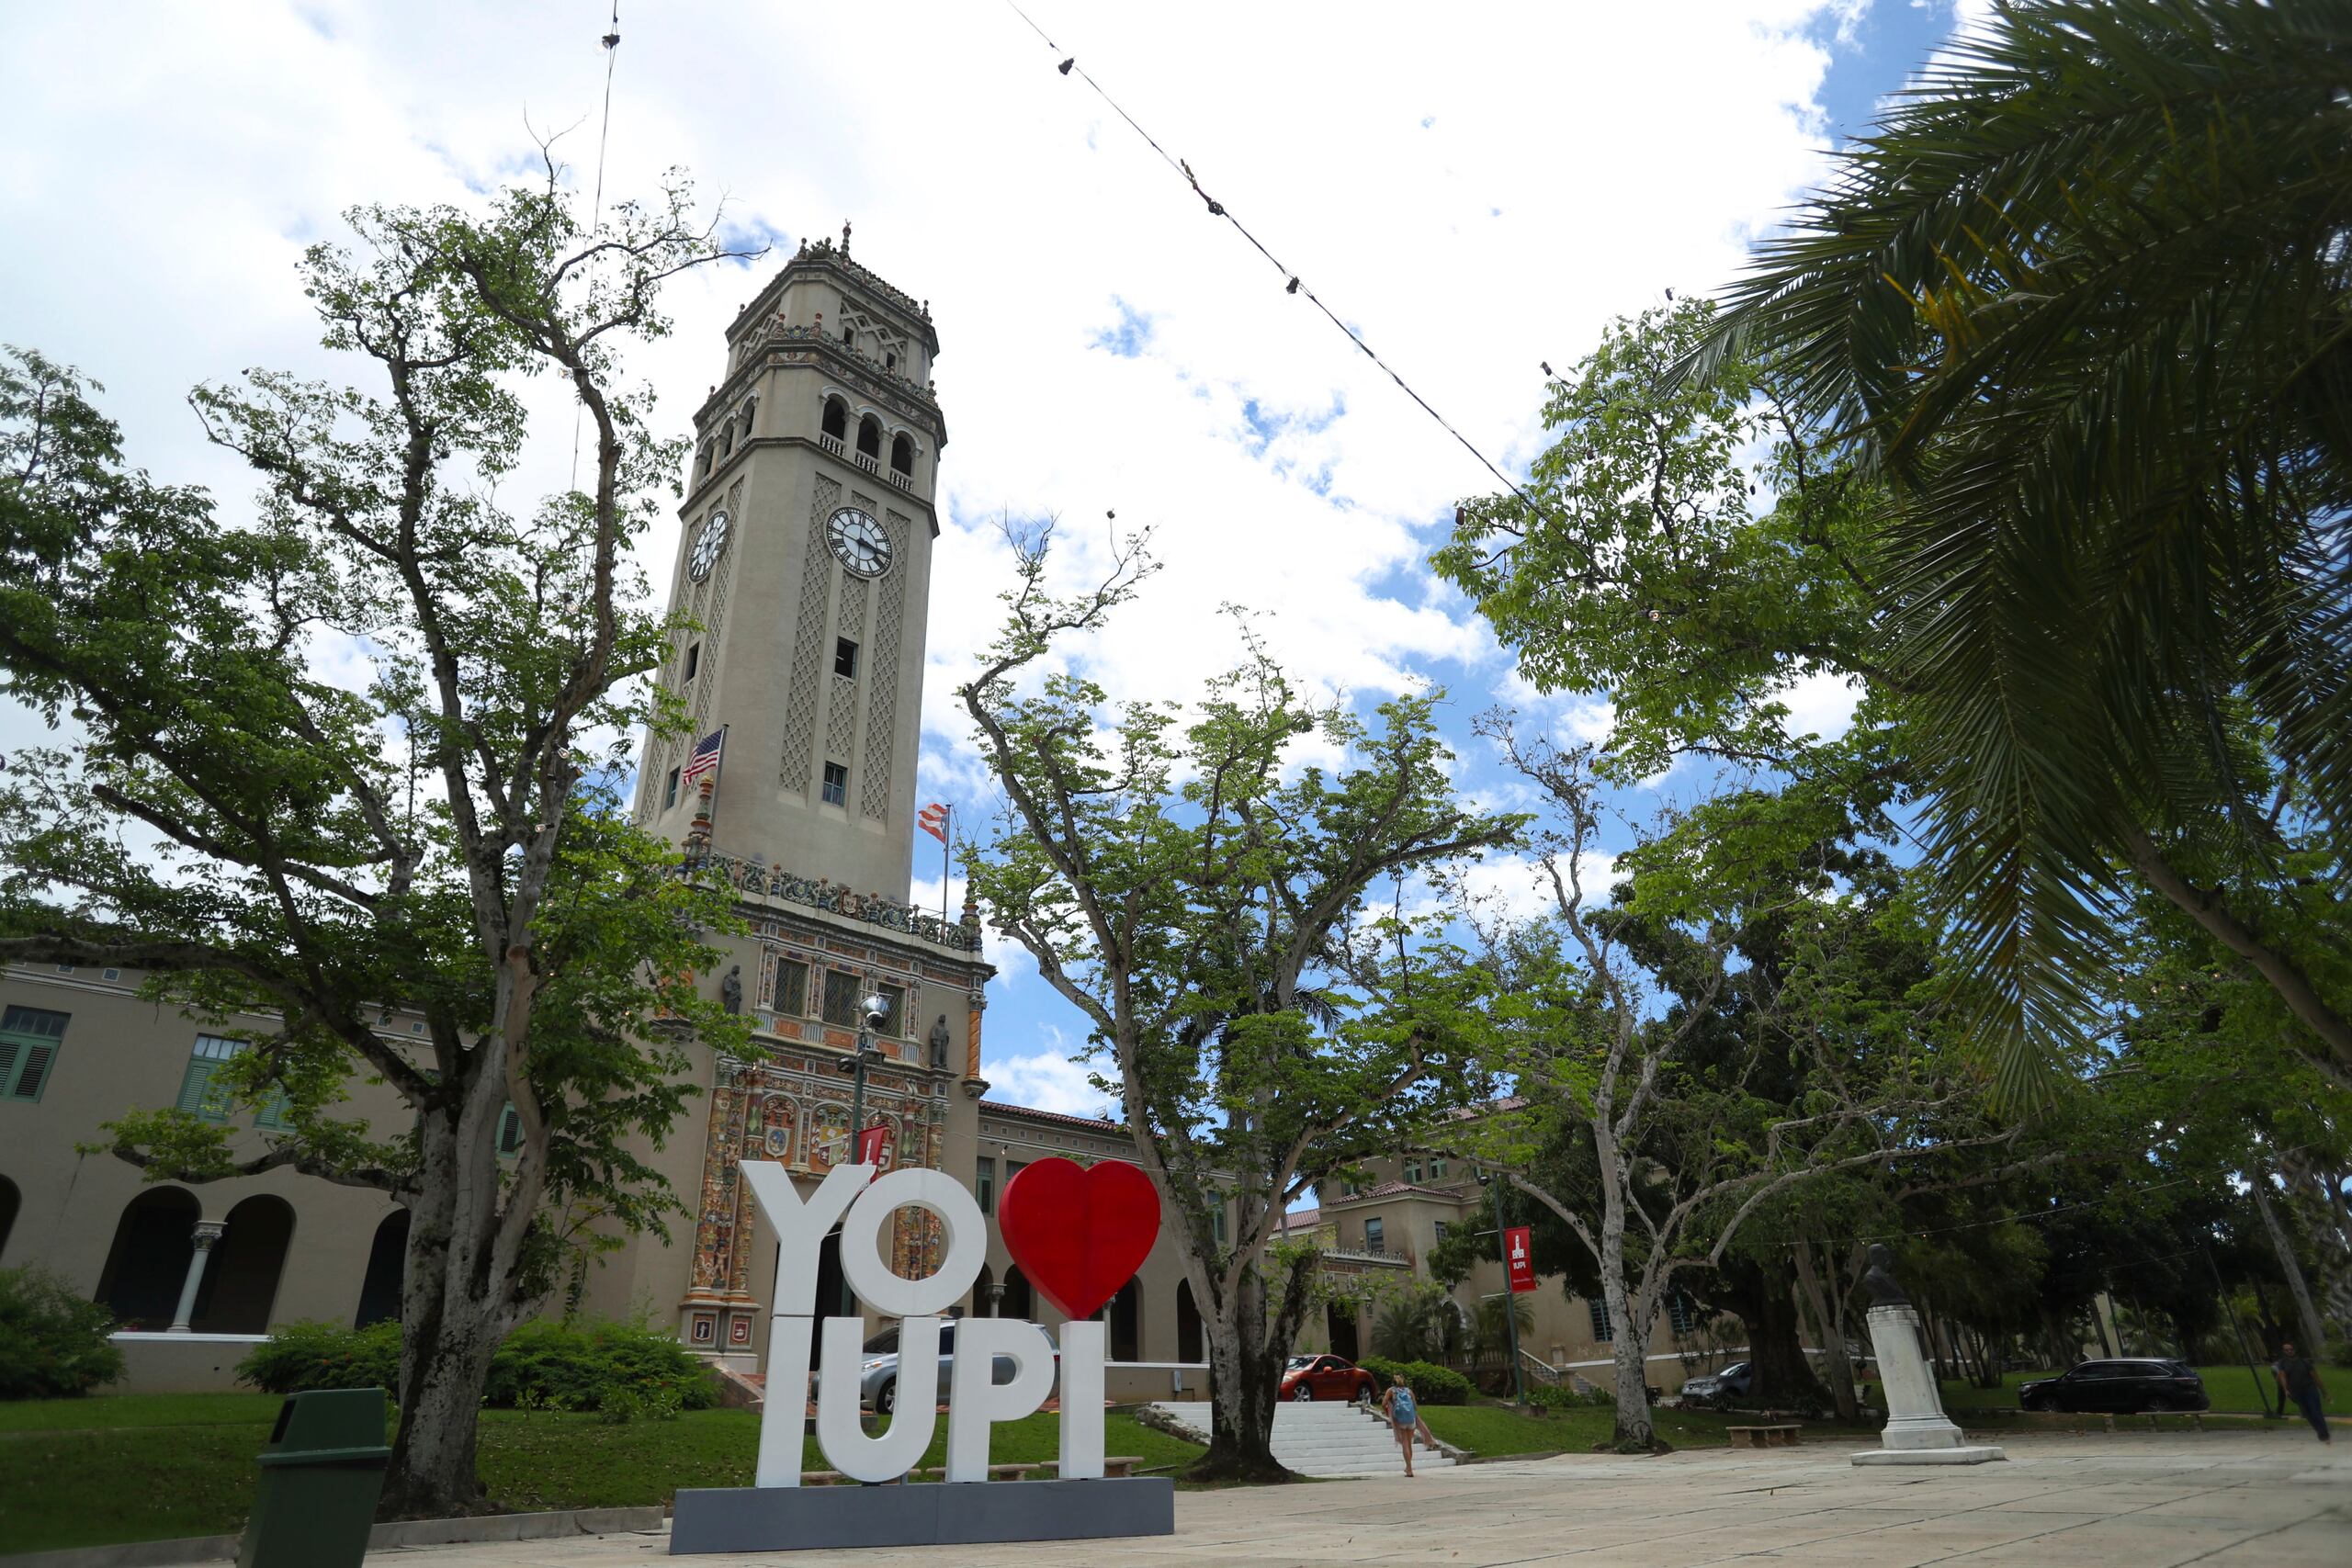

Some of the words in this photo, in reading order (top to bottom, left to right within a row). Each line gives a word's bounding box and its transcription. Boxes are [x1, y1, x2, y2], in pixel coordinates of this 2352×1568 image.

[739, 1159, 988, 1317] YO
[1513, 1261, 1526, 1270] IUPI
[755, 1314, 1105, 1488] IUPI
